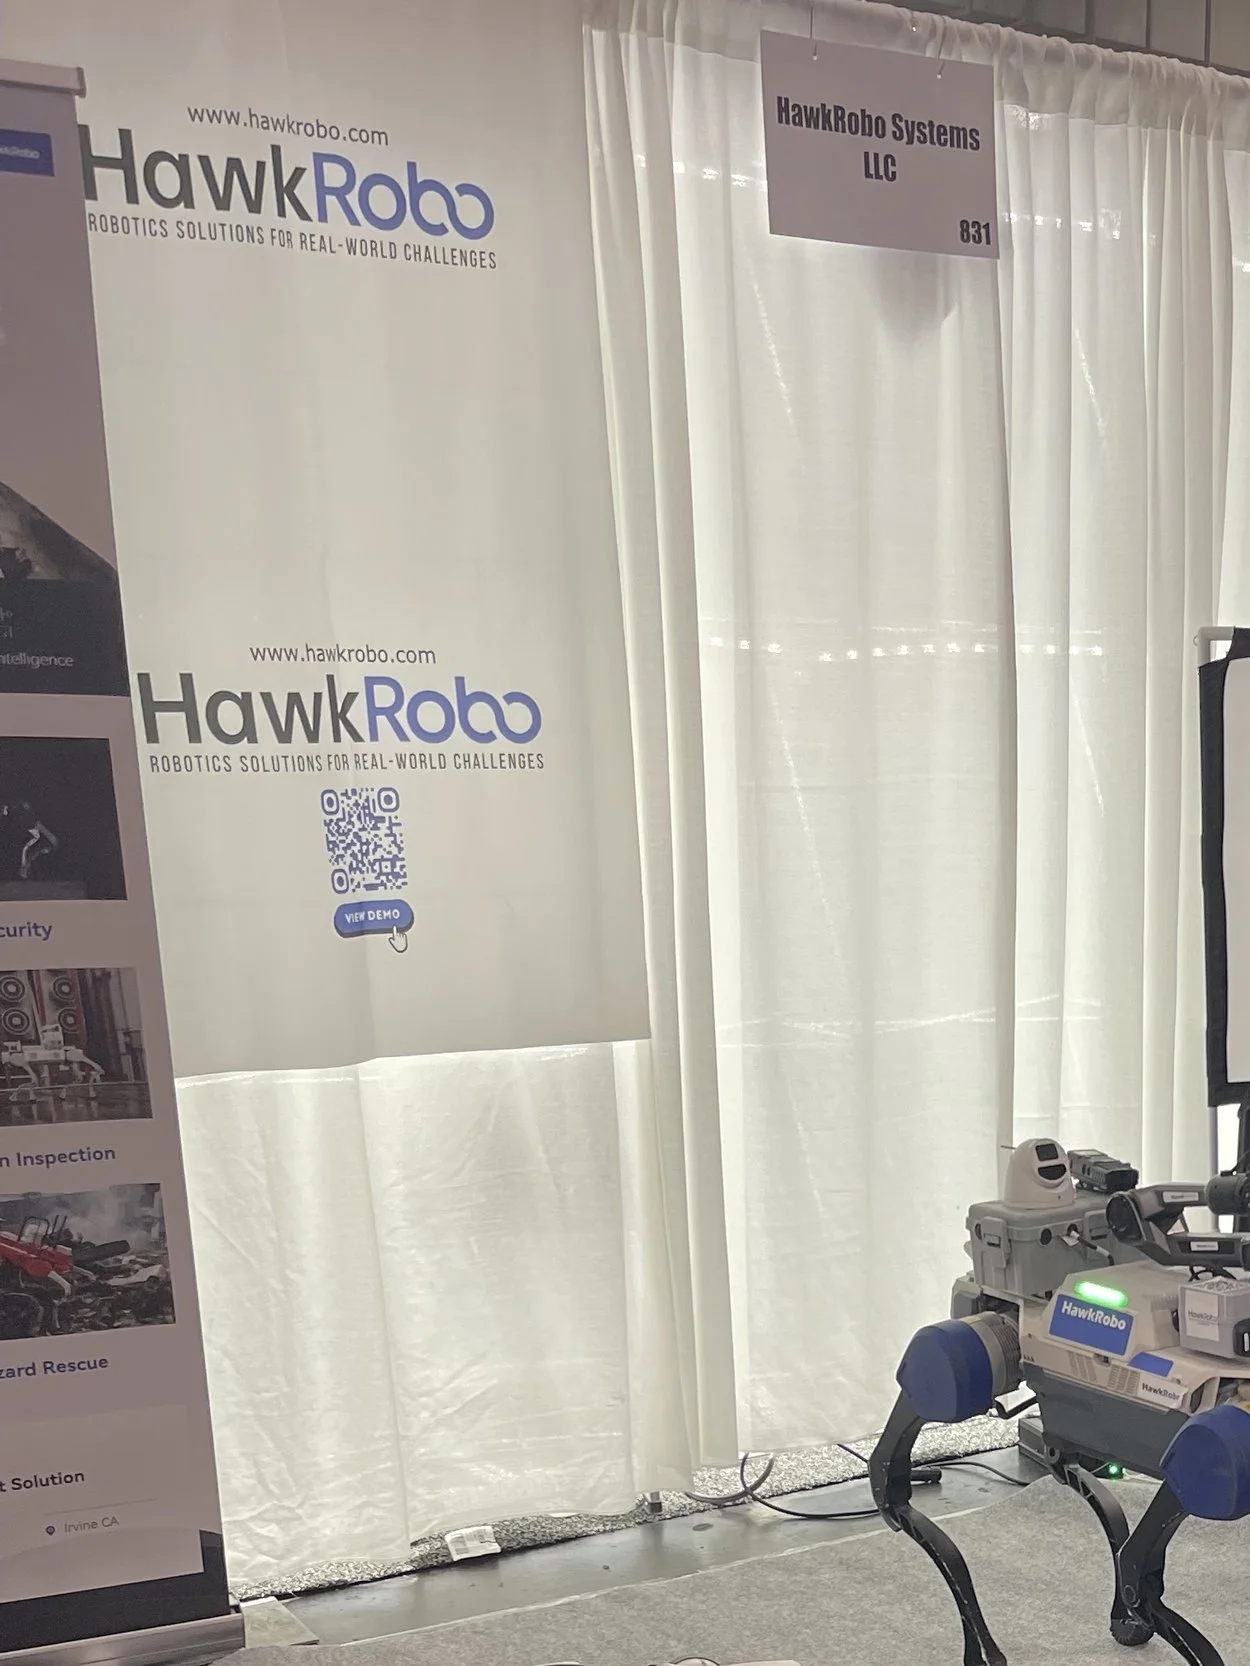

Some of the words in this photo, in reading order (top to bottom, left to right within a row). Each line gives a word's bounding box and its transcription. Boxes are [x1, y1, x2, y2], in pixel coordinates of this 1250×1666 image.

[187, 105, 389, 146] www.hawkrobo.com
[776, 96, 886, 139] HawkRobo
[891, 113, 981, 151] Systems
[863, 151, 897, 182] LLC
[78, 124, 495, 241] HawkRobo
[88, 213, 168, 238] ROBOTICS
[176, 220, 265, 245] SOLUTIONS
[270, 228, 293, 249] FOR
[300, 232, 398, 259] REAL-WORLD
[403, 243, 497, 269] CHALLENGES
[959, 219, 991, 245] 831
[249, 643, 437, 665] www.hawkrobo.com
[136, 672, 542, 745] HawkRobo
[149, 755, 232, 773] ROBOTICS
[239, 754, 323, 773] SOLUTIONS
[327, 753, 350, 771] FOR
[354, 752, 447, 770] REAL-WORLD
[453, 752, 545, 770] CHALLENGES
[344, 910, 365, 924] VIEW
[367, 908, 400, 921] DEMO
[16, 1146, 116, 1169] Inspection
[1061, 1300, 1127, 1331] HawkRobo
[43, 1358, 108, 1375] Rescue
[11, 1472, 85, 1491] Solution
[64, 1521, 98, 1533] Irvine
[101, 1516, 119, 1528] CA
